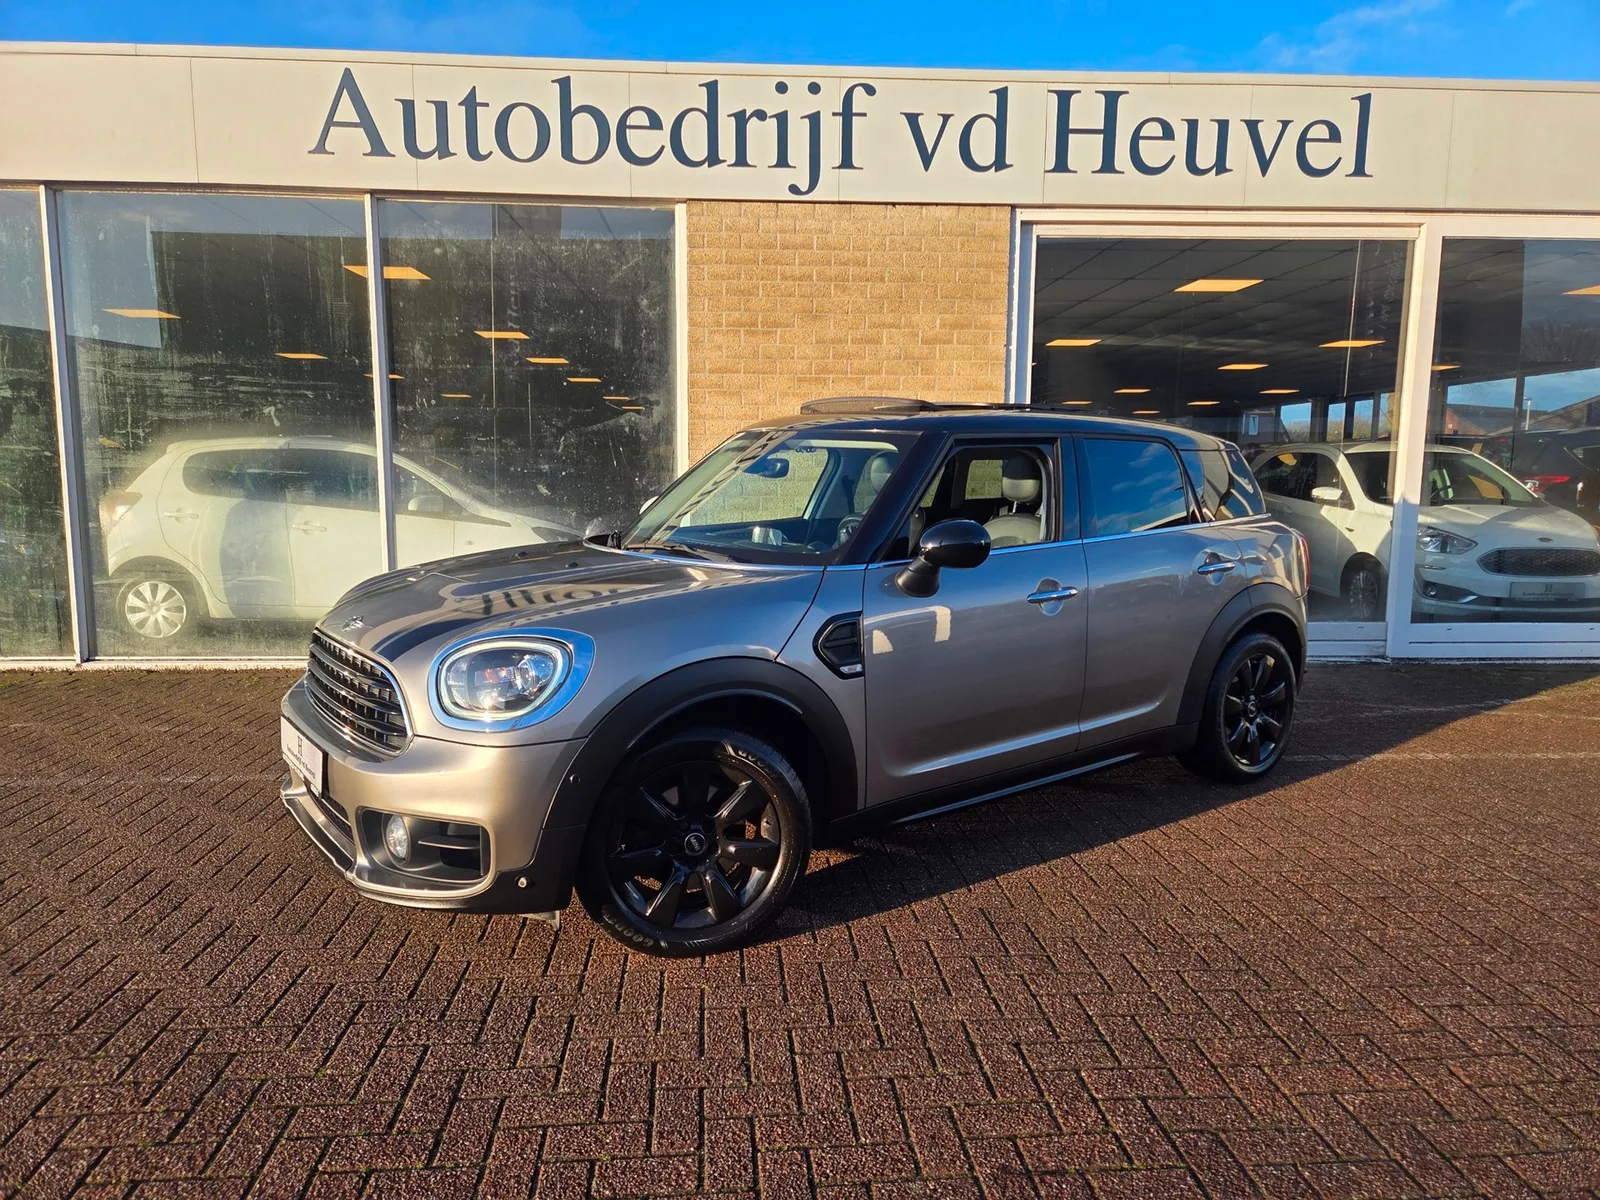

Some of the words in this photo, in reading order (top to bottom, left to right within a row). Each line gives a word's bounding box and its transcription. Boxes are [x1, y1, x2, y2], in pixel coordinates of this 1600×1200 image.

[308, 67, 877, 196] Autobedrijf
[900, 85, 1014, 173] vd
[1044, 90, 1373, 178] Heuvel
[689, 836, 701, 851] MINI
